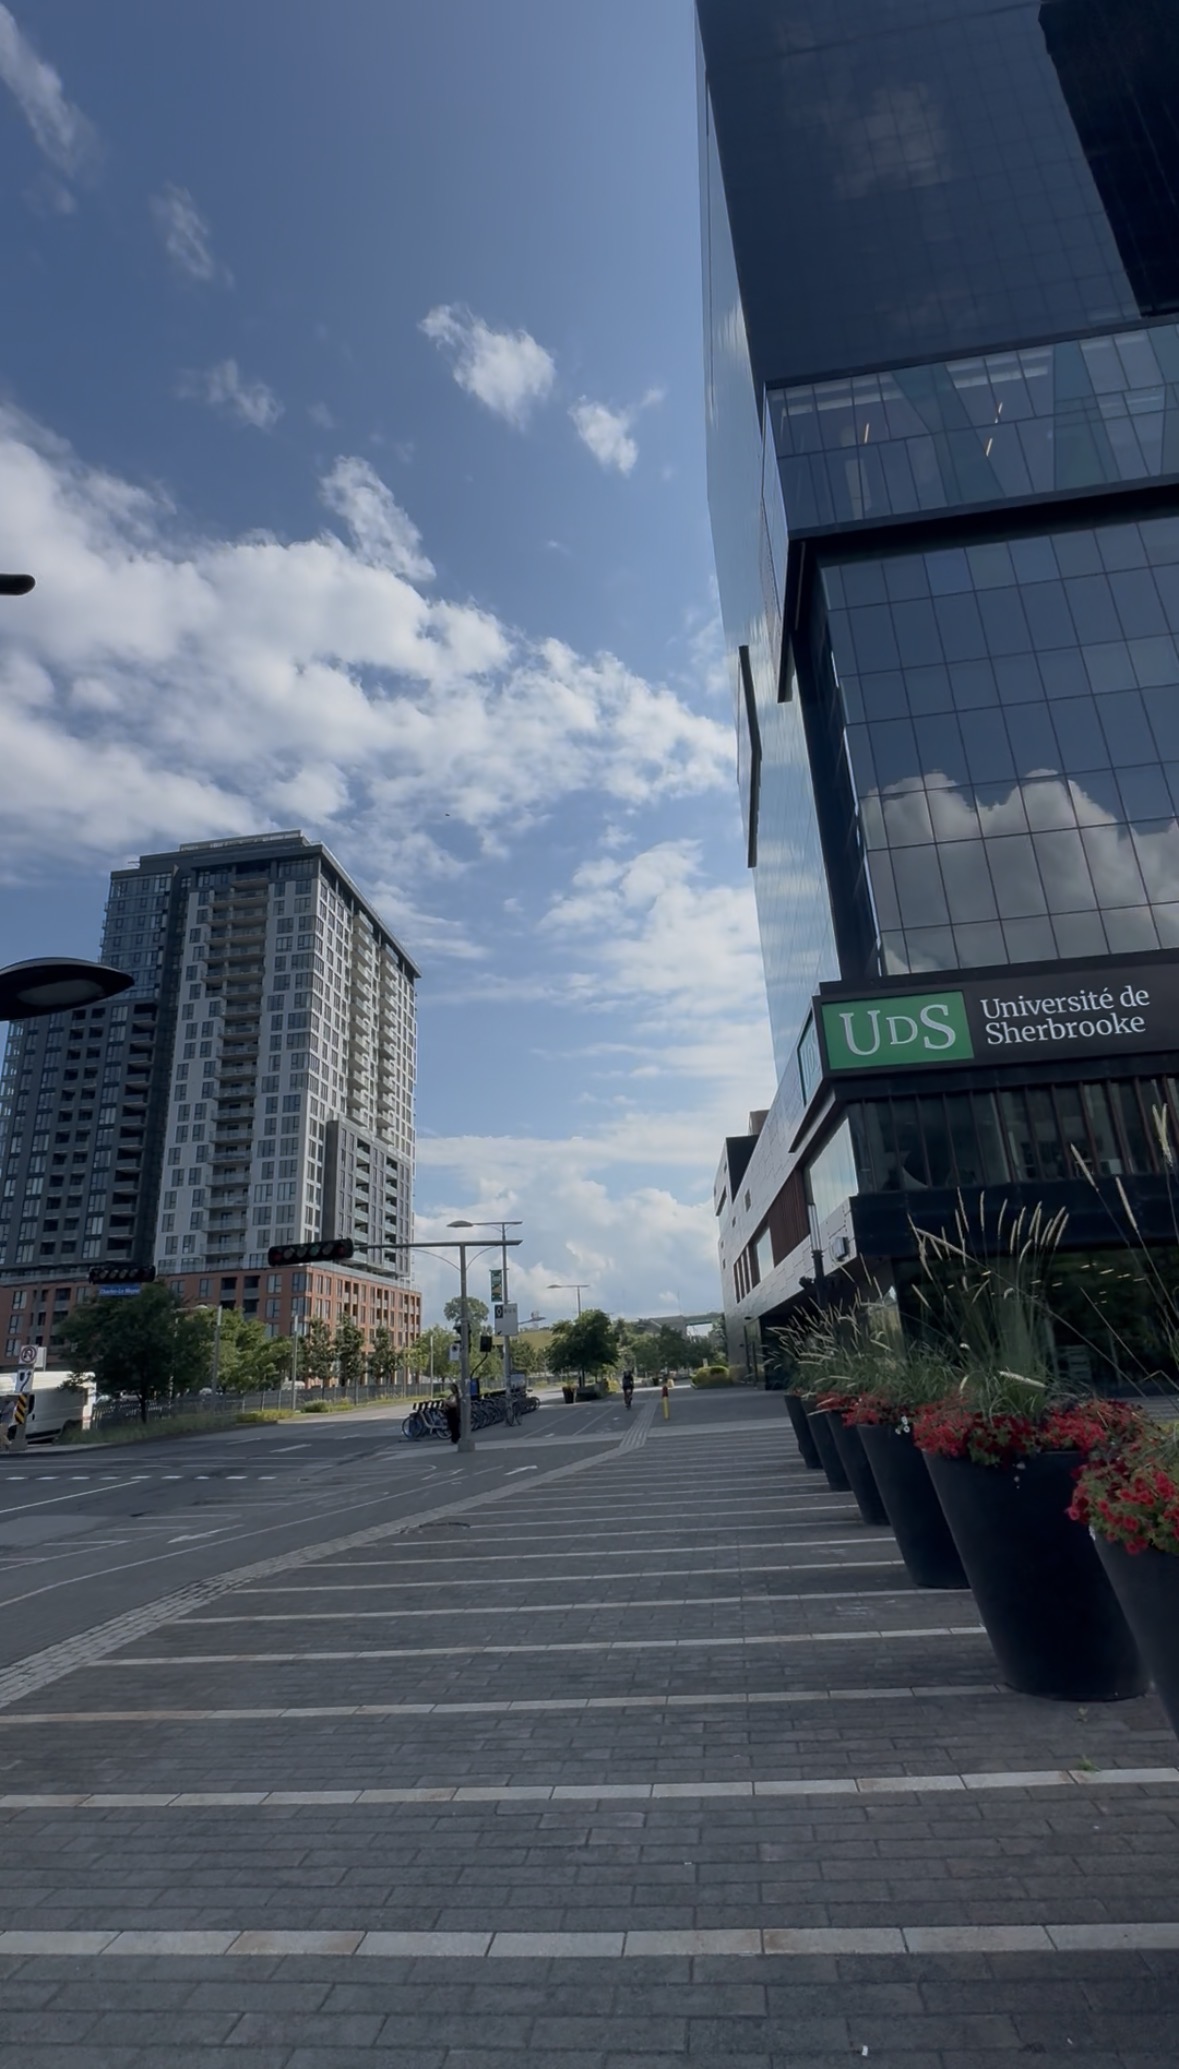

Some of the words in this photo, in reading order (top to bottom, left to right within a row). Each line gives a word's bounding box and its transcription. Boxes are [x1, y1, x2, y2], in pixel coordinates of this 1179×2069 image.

[980, 987, 1114, 1020] Université
[1119, 985, 1150, 1008] de
[985, 1012, 1146, 1045] Sherbrooke
